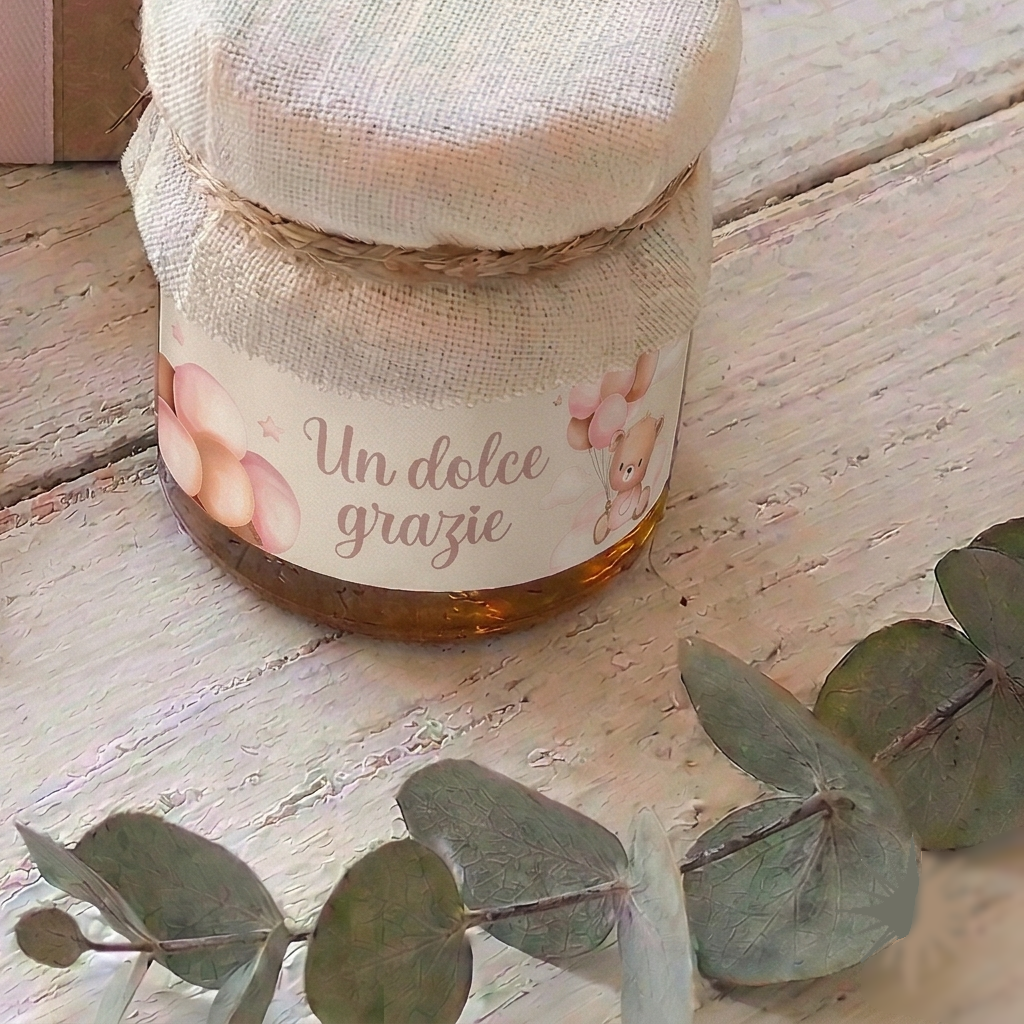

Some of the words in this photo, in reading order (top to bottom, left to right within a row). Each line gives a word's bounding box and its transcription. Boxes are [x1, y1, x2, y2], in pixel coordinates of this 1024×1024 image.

[302, 416, 396, 487] Un
[407, 431, 550, 491] dolce
[334, 503, 512, 570] grazie
